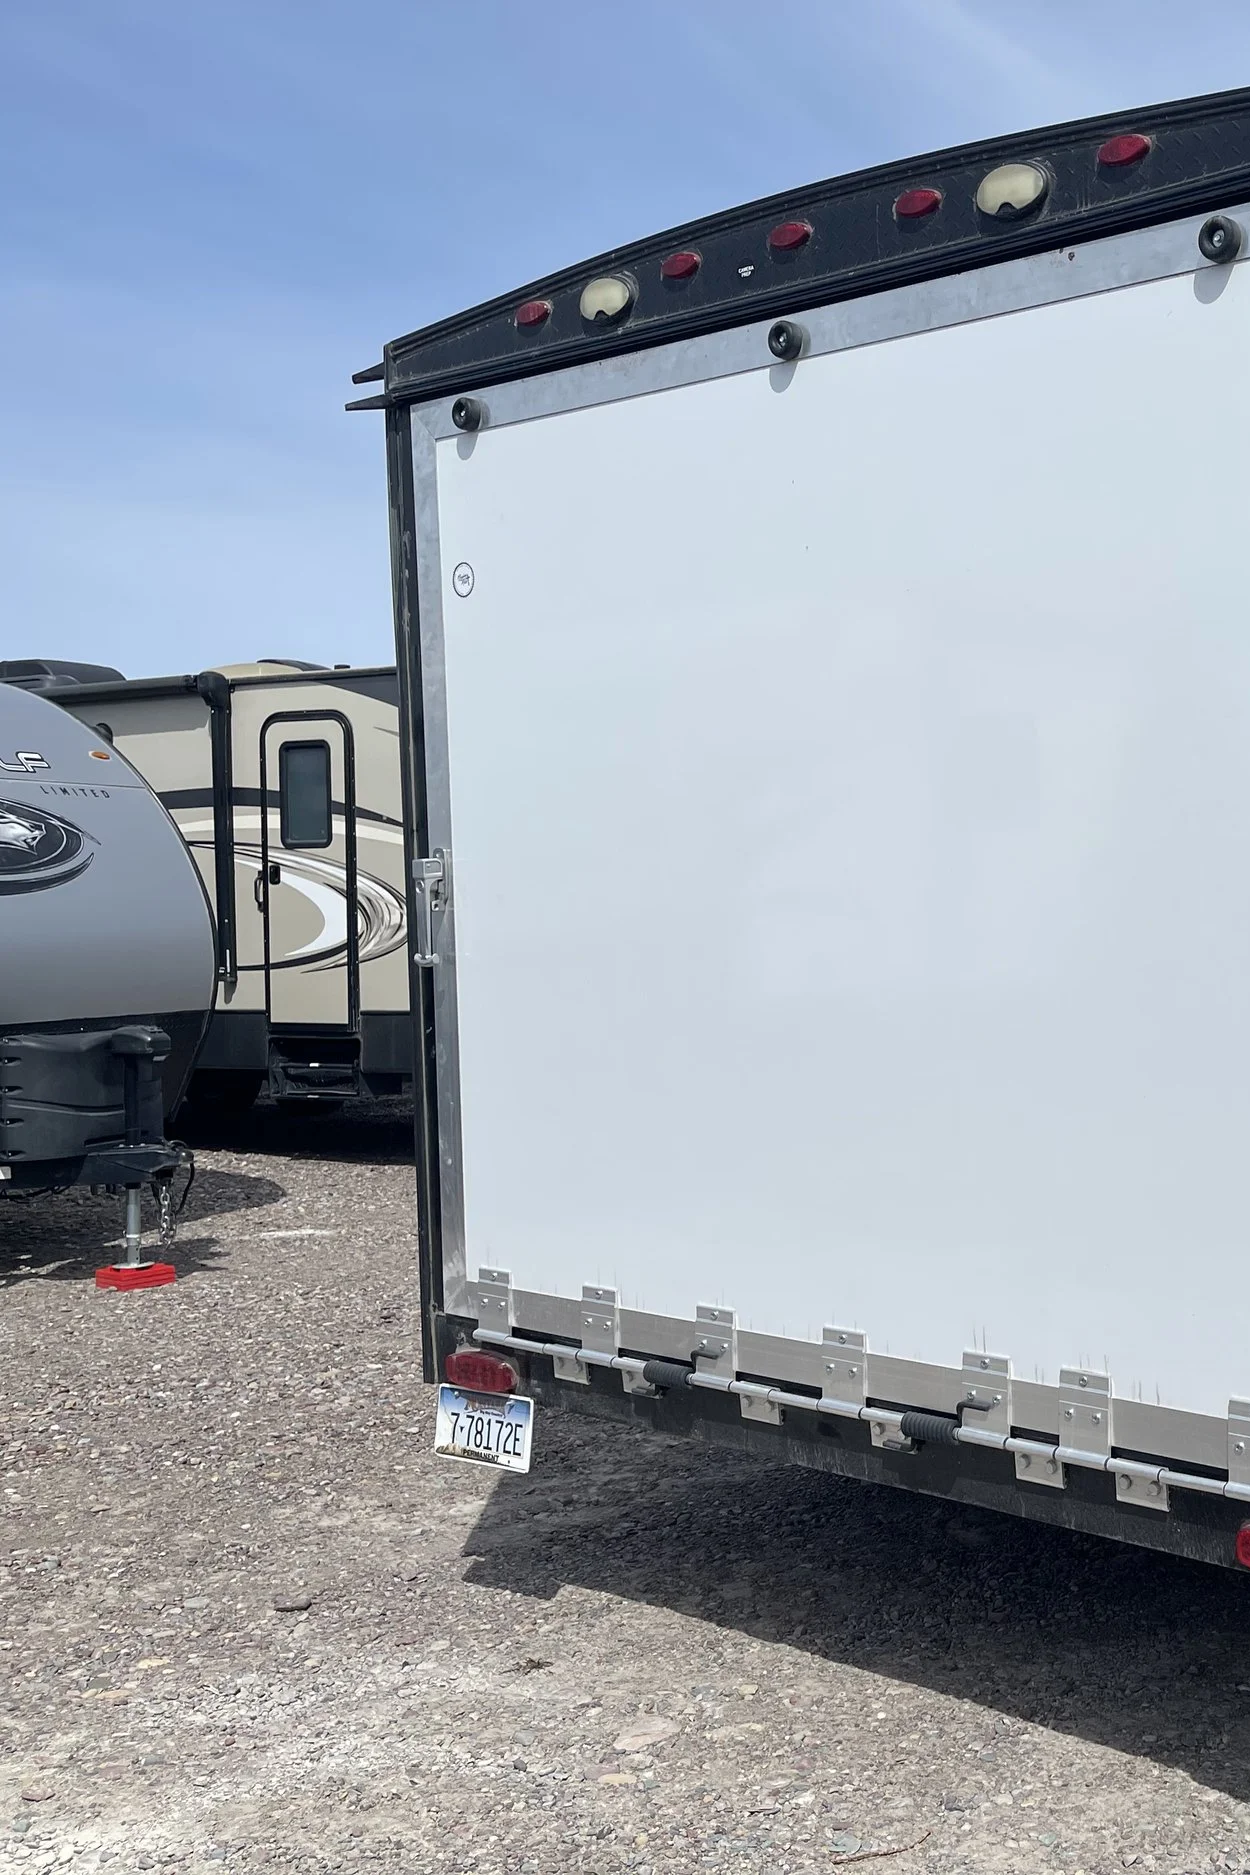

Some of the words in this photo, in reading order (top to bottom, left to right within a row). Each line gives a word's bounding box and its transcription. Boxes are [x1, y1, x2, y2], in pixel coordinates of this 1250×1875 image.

[738, 265, 755, 274] CAMERA
[39, 785, 110, 799] LIMITED
[462, 1448, 500, 1463] PERMANENT
